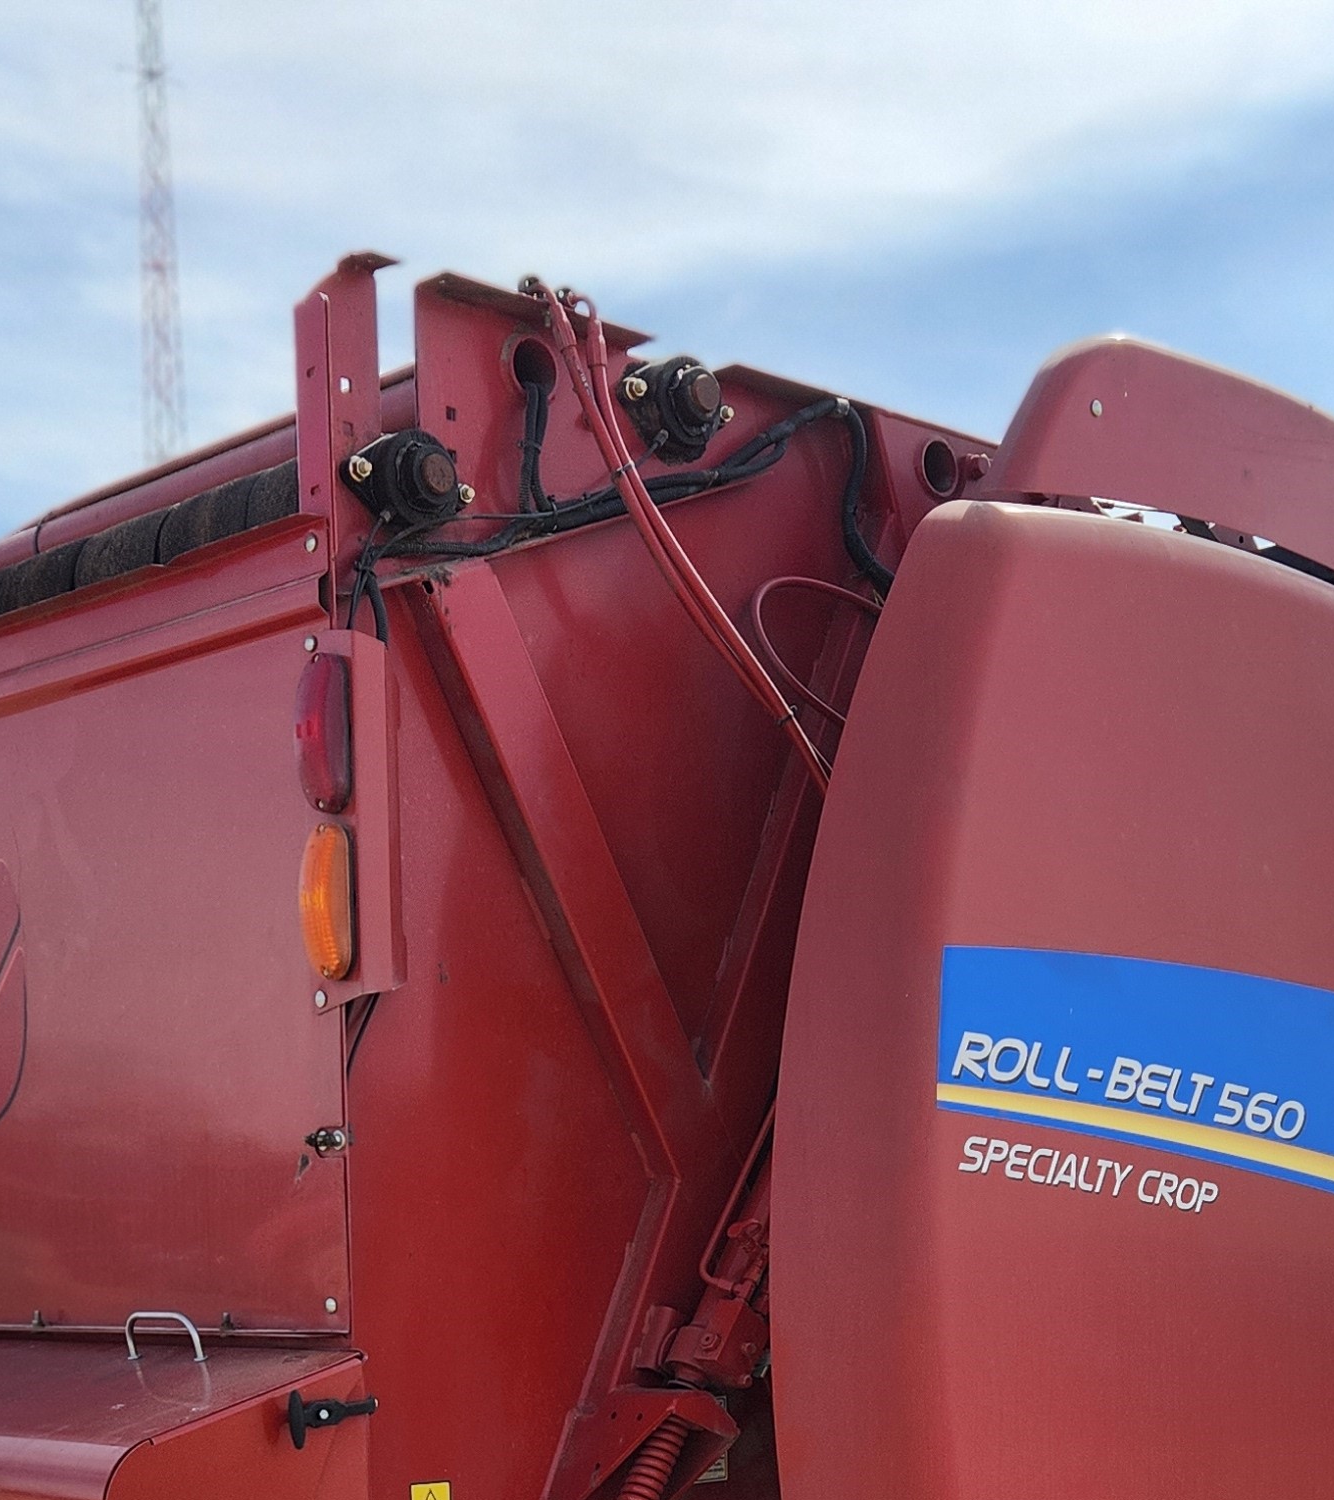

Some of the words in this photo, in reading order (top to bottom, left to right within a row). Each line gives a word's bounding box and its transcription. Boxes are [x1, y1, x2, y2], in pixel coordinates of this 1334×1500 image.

[950, 1031, 1215, 1116] ROLL-BELT
[1213, 1083, 1306, 1140] 560
[958, 1136, 1134, 1198] SPECIALTY
[1137, 1170, 1219, 1214] CROP
